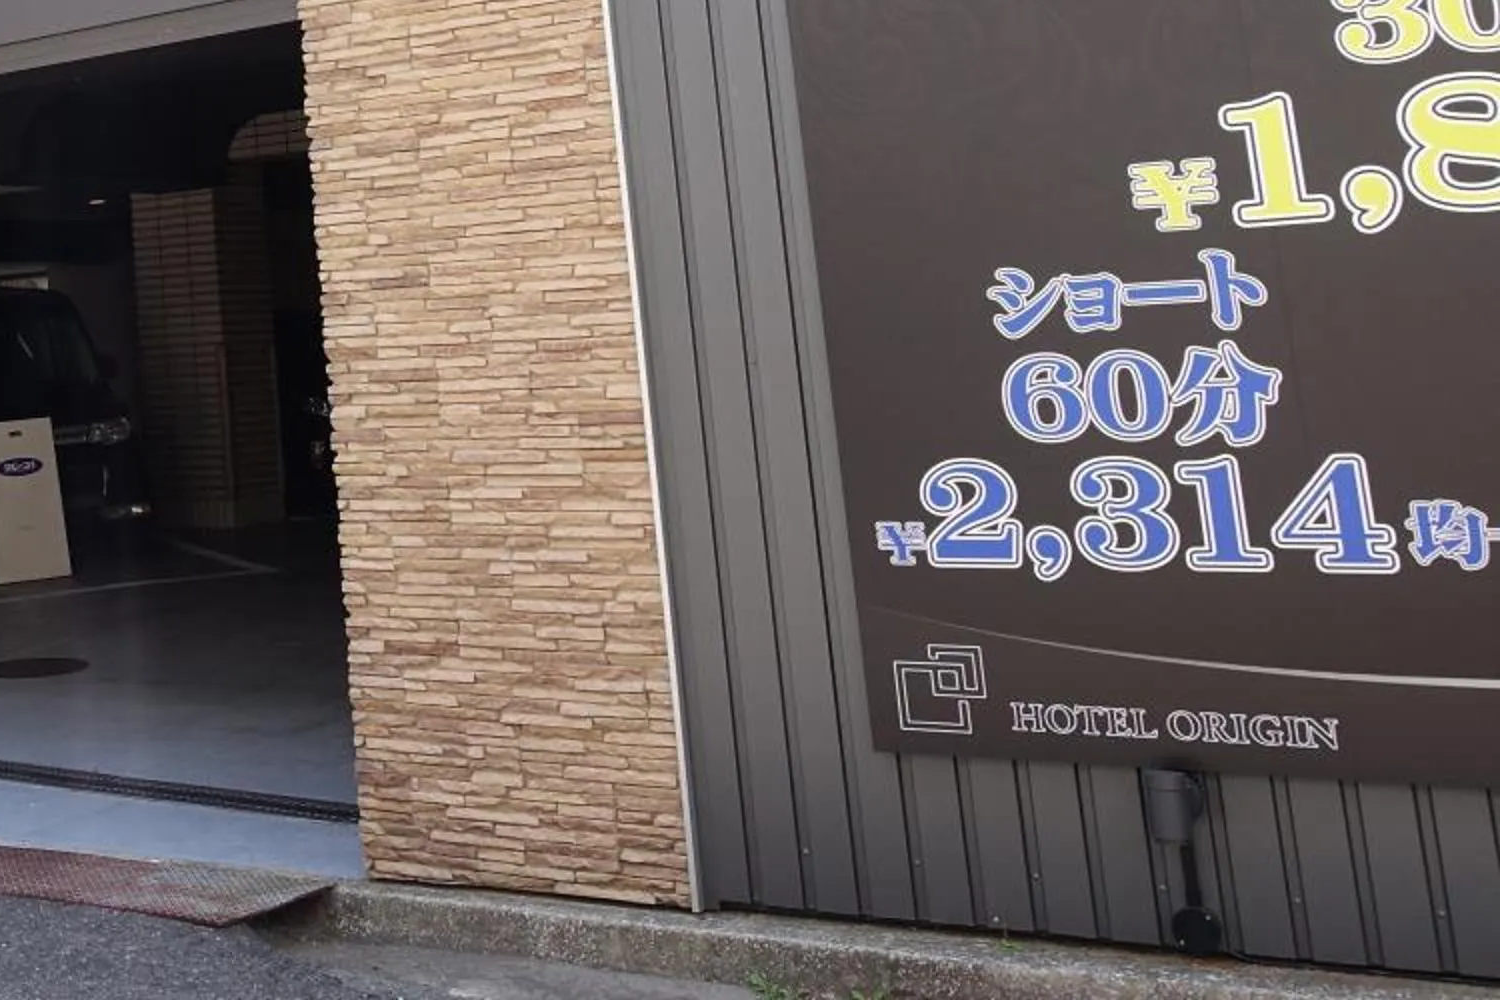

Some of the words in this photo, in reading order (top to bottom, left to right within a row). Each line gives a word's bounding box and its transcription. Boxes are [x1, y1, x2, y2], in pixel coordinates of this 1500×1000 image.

[986, 248, 1269, 340] ショート
[1002, 340, 1283, 447] 60分
[876, 453, 1500, 582] ¥2,314均
[1009, 700, 1159, 739] HOTEL
[1165, 709, 1340, 751] ORIGIN
